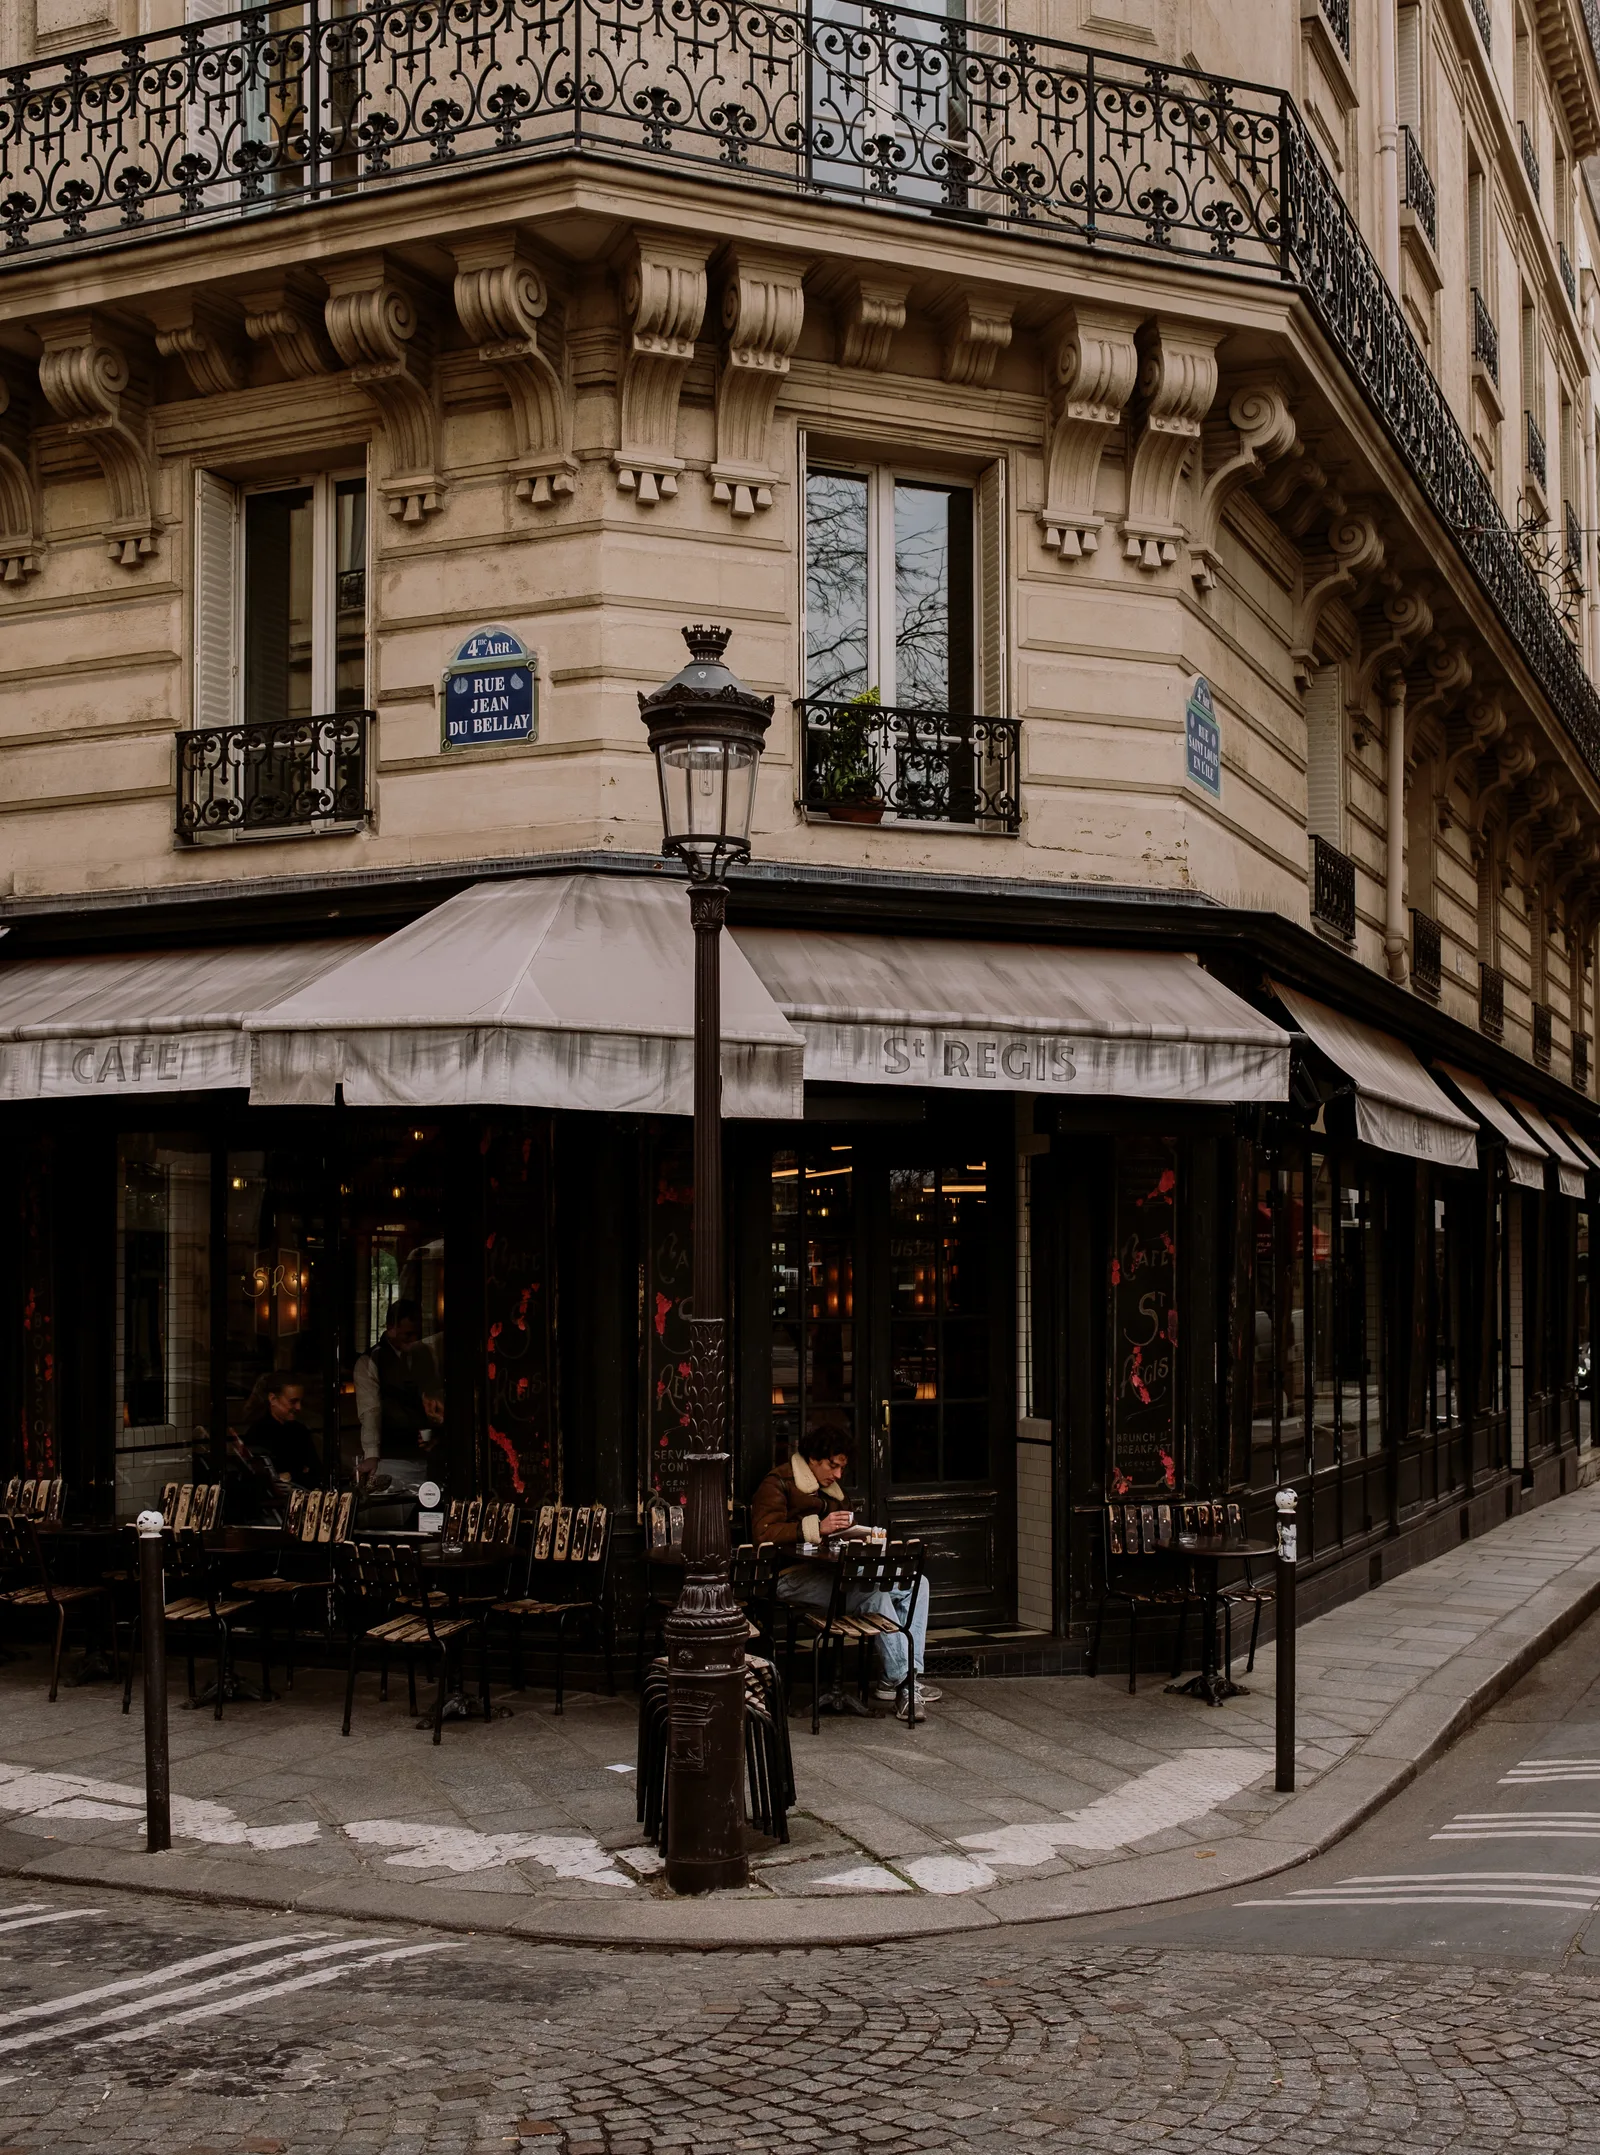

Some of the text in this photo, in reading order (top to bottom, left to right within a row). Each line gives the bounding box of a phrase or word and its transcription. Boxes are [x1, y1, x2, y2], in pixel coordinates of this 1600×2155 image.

[473, 676, 505, 694] RUE
[470, 696, 509, 714] JEAN
[449, 713, 530, 736] DU BELLAY
[1198, 724, 1209, 743] RUE
[1188, 734, 1218, 767] SAINT LOUIS
[1193, 755, 1201, 771] EN
[71, 1042, 181, 1085] CAFE
[943, 1040, 1077, 1083] REGIS
[657, 1231, 690, 1284] CA
[1116, 1432, 1156, 1443] BRUNCH
[1117, 1443, 1171, 1455] BREAKFAST
